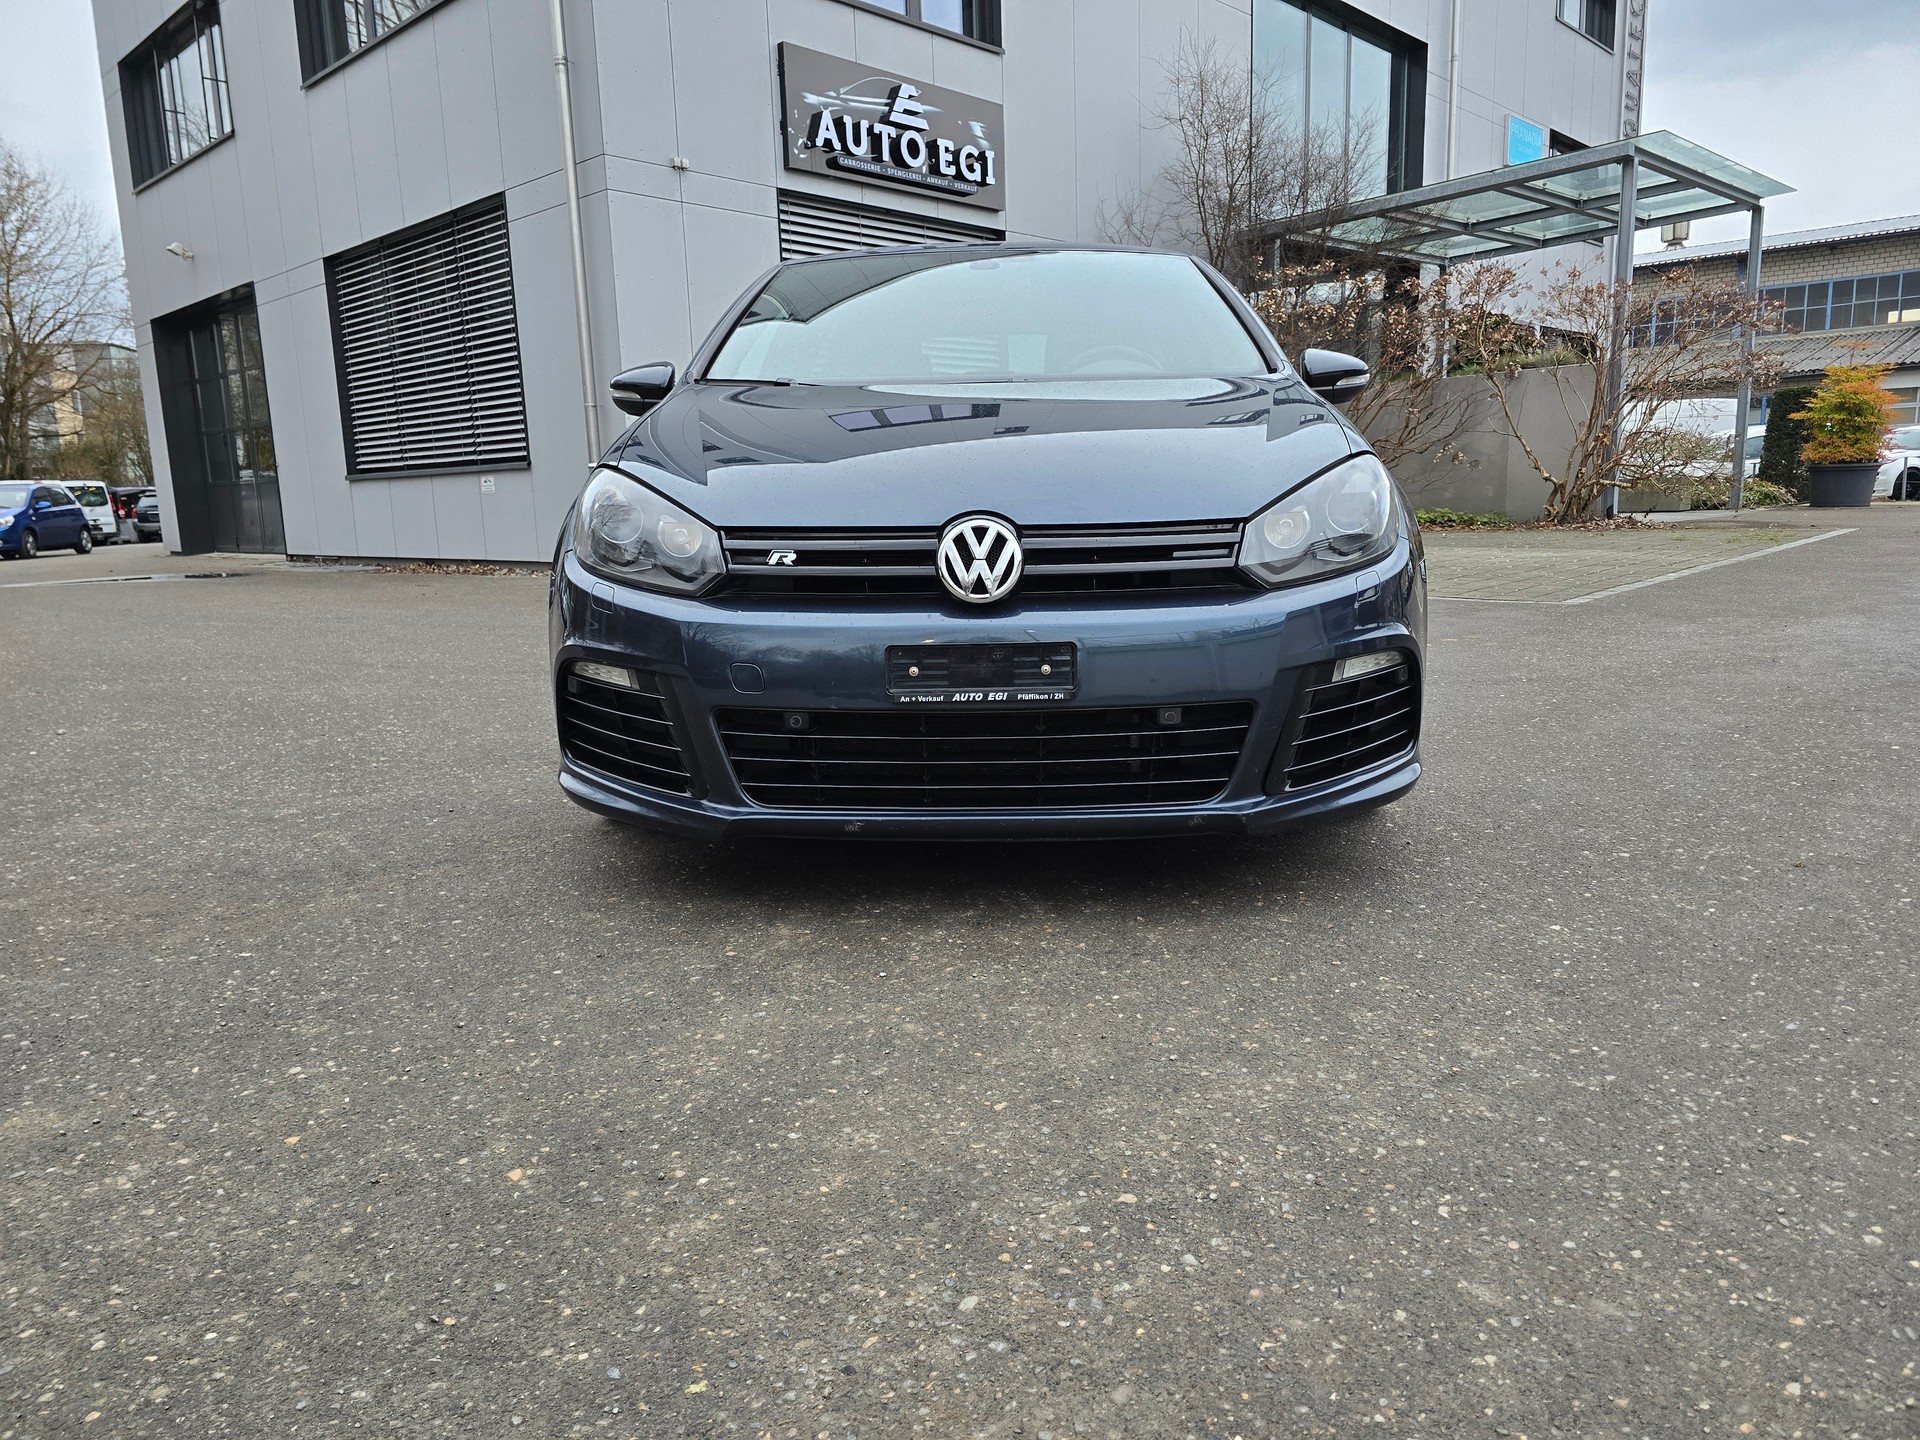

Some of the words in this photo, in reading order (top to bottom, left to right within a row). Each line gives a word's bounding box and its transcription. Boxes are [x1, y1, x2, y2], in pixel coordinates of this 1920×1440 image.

[814, 108, 927, 169] AUTO
[936, 137, 996, 185] EGI
[840, 156, 882, 172] CARROSSERIE
[887, 167, 922, 181] SPENGLEREI
[926, 176, 949, 187] ANKAUF
[953, 182, 978, 193] VERKAUF
[766, 549, 797, 566] R
[952, 693, 983, 701] AUTO
[988, 692, 1008, 700] EGI
